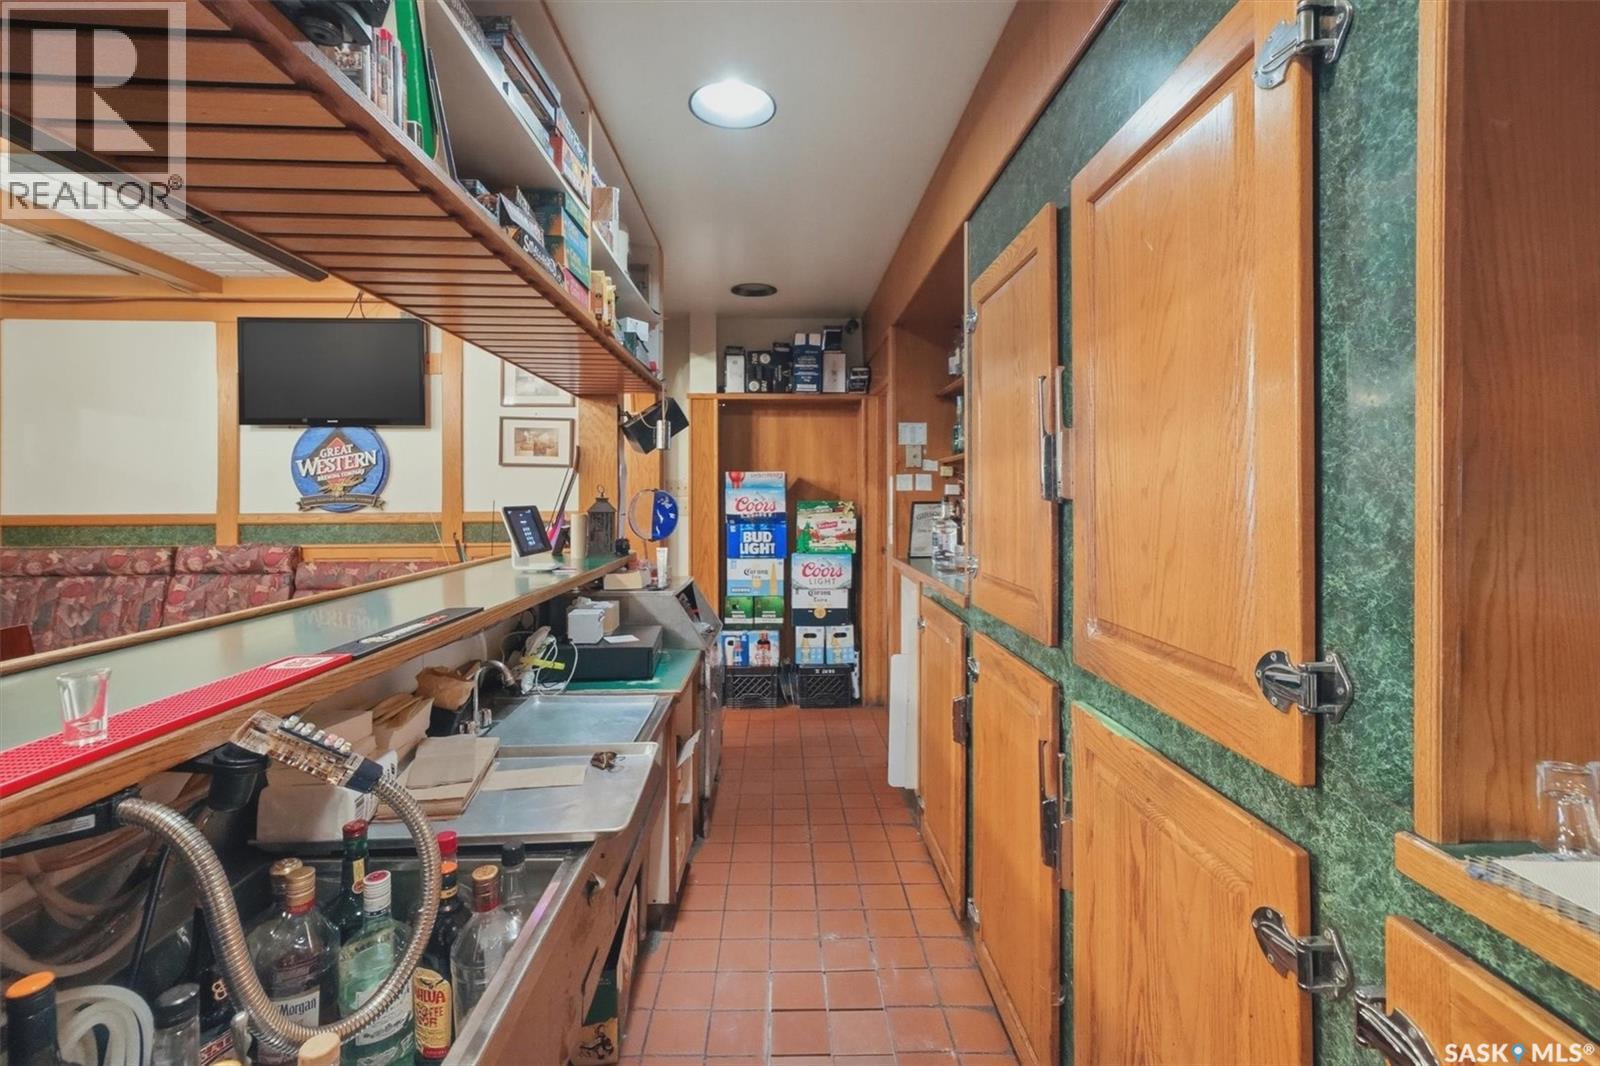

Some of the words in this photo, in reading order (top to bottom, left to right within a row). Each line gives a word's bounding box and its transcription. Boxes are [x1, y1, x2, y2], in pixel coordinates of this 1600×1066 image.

[320, 444, 353, 458] GREAT
[295, 449, 376, 477] WESTERN
[734, 496, 776, 512] Coors
[743, 531, 773, 542] BUD
[740, 542, 775, 554] LIGHT
[801, 561, 843, 577] Coors
[279, 998, 317, 1017] Morgan
